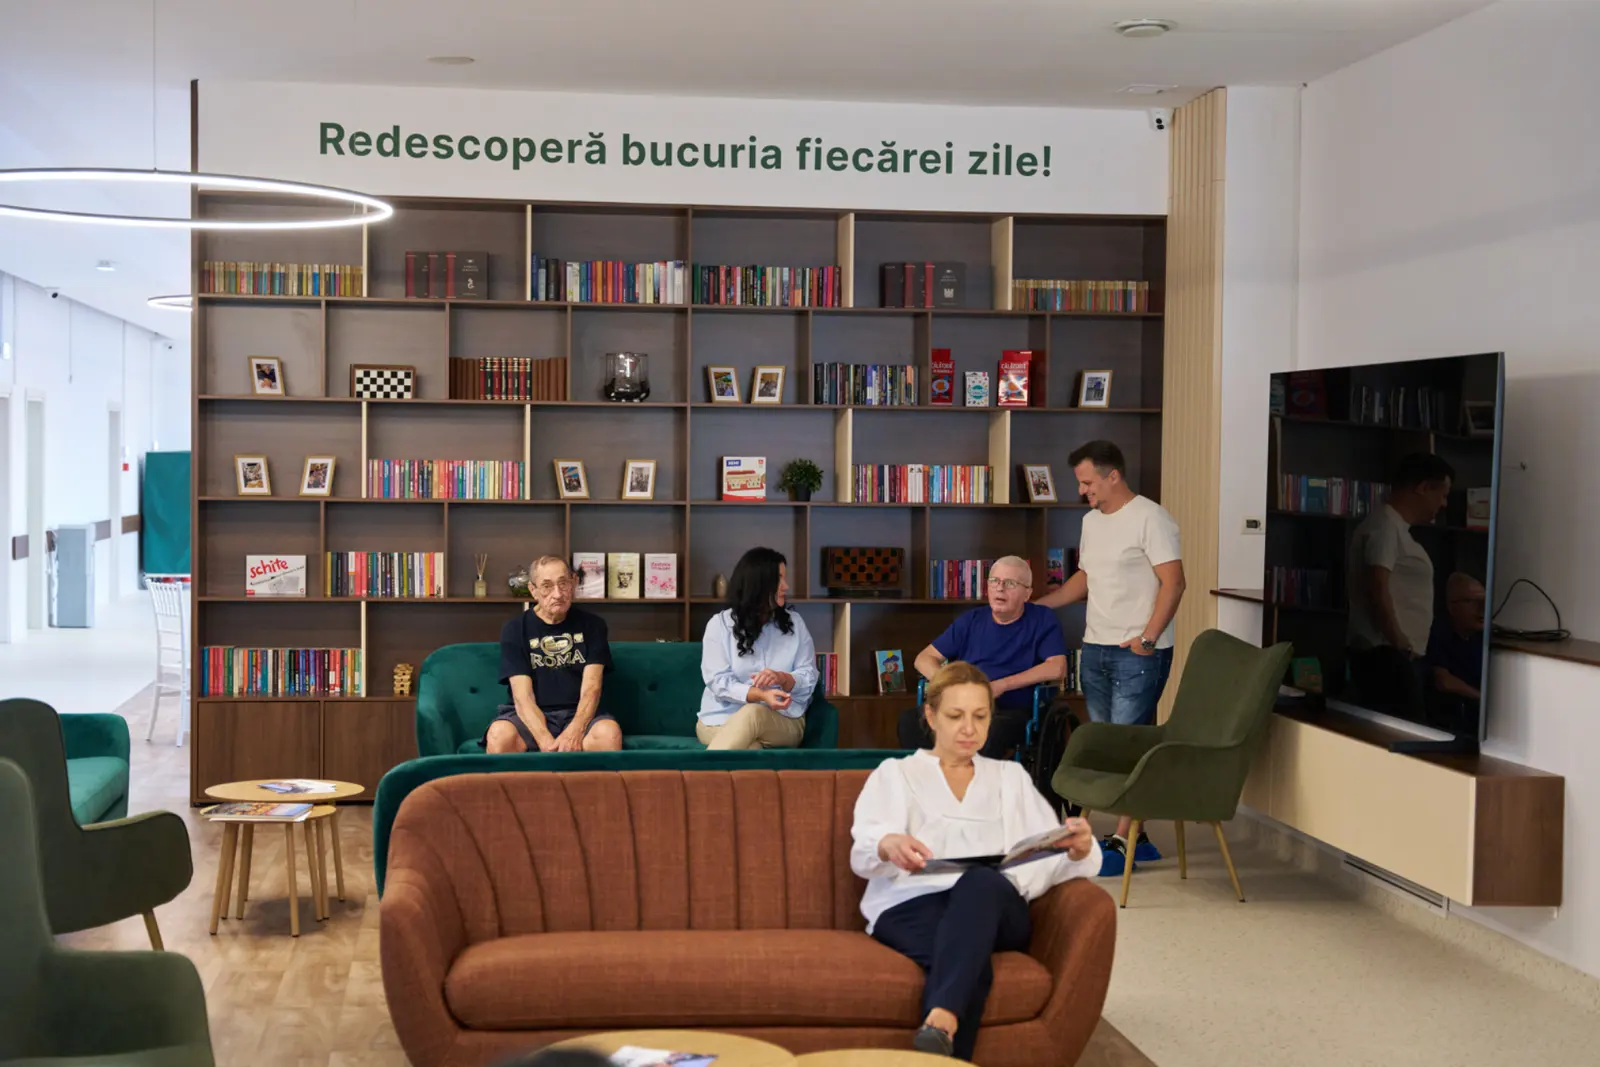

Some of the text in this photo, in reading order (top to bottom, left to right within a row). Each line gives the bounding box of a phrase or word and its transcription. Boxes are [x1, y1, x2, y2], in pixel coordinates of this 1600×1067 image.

[320, 122, 1051, 177] Redescoperă bucuria fiecărei zile!
[529, 648, 586, 670] ROMA
